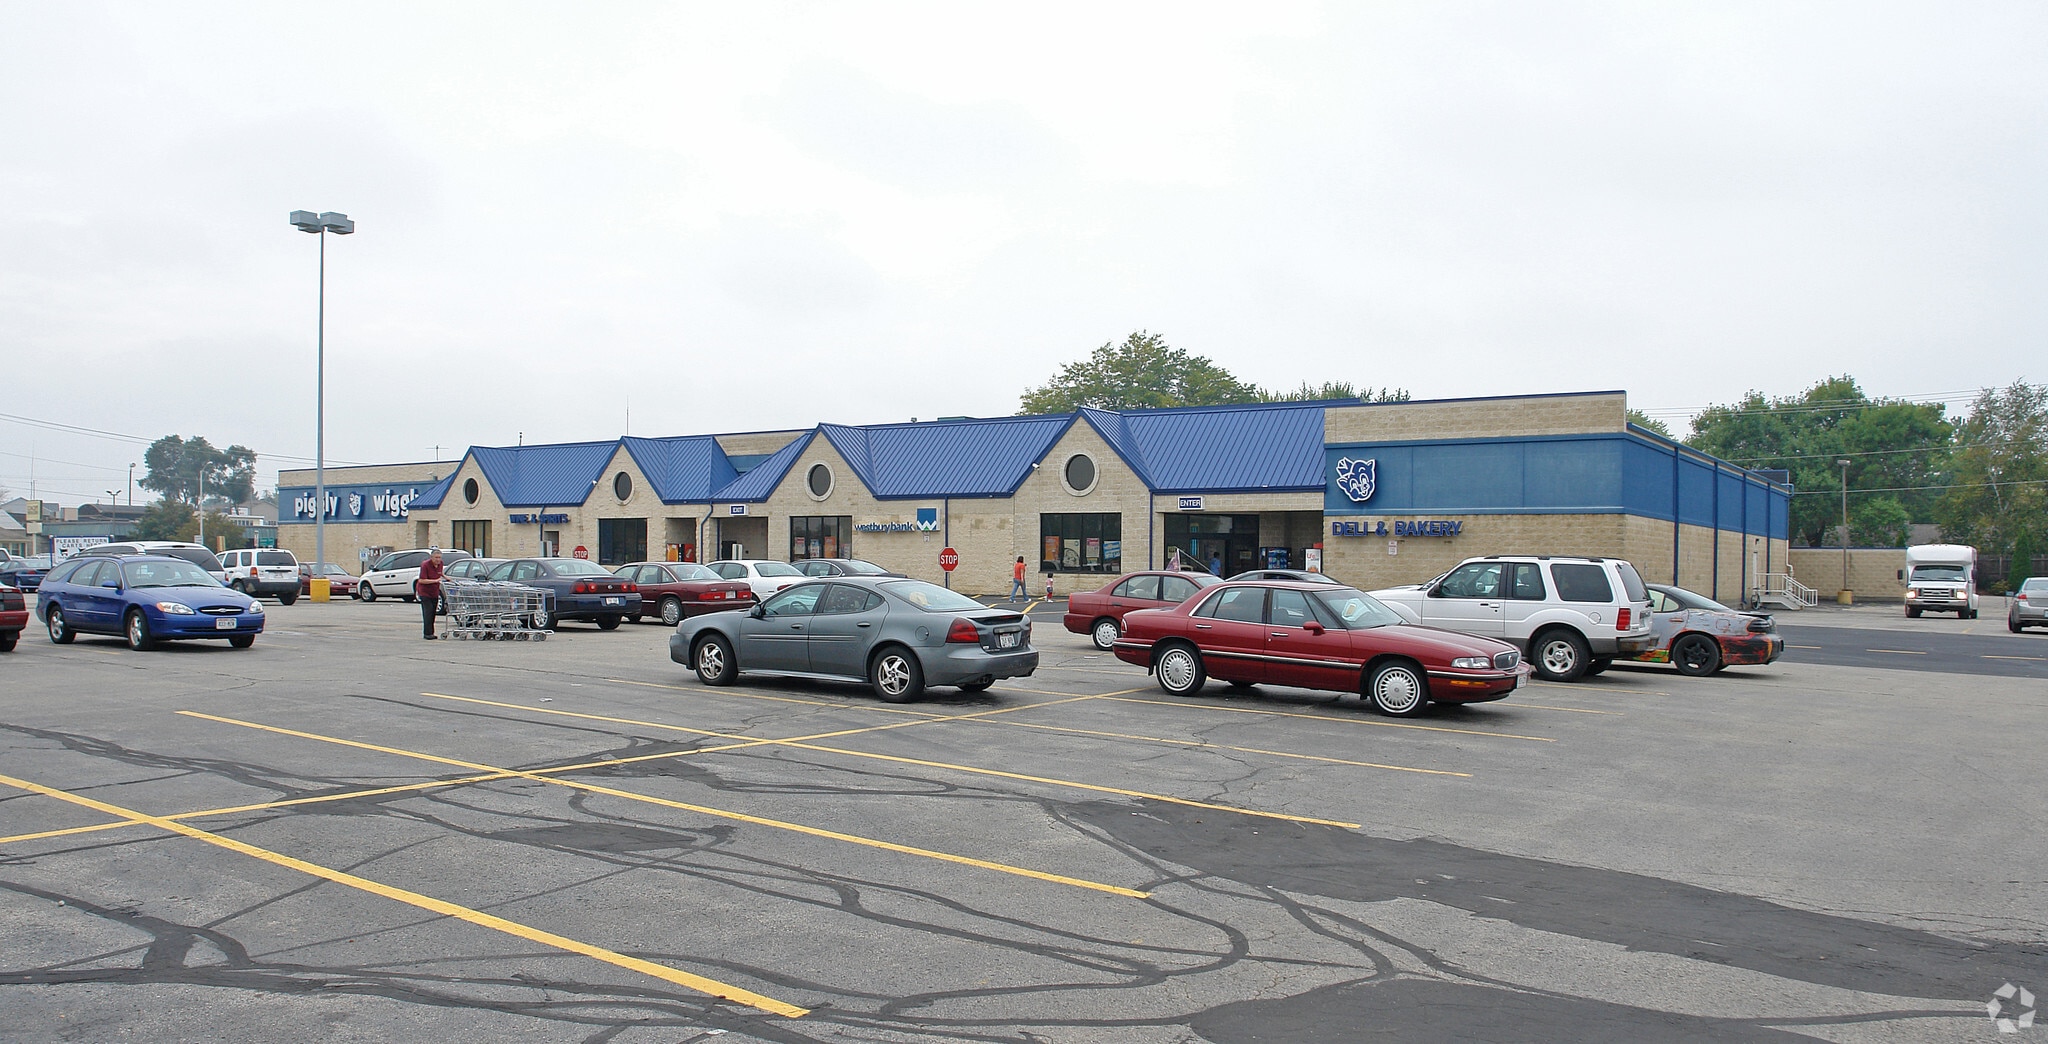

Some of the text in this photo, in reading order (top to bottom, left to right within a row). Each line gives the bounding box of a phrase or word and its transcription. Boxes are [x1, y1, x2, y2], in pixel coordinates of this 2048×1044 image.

[294, 491, 338, 519] pigly
[1180, 499, 1201, 507] ENTER
[1332, 520, 1464, 537] DELI & BAKERY
[574, 550, 588, 559] STOP
[940, 554, 958, 565] STOP
